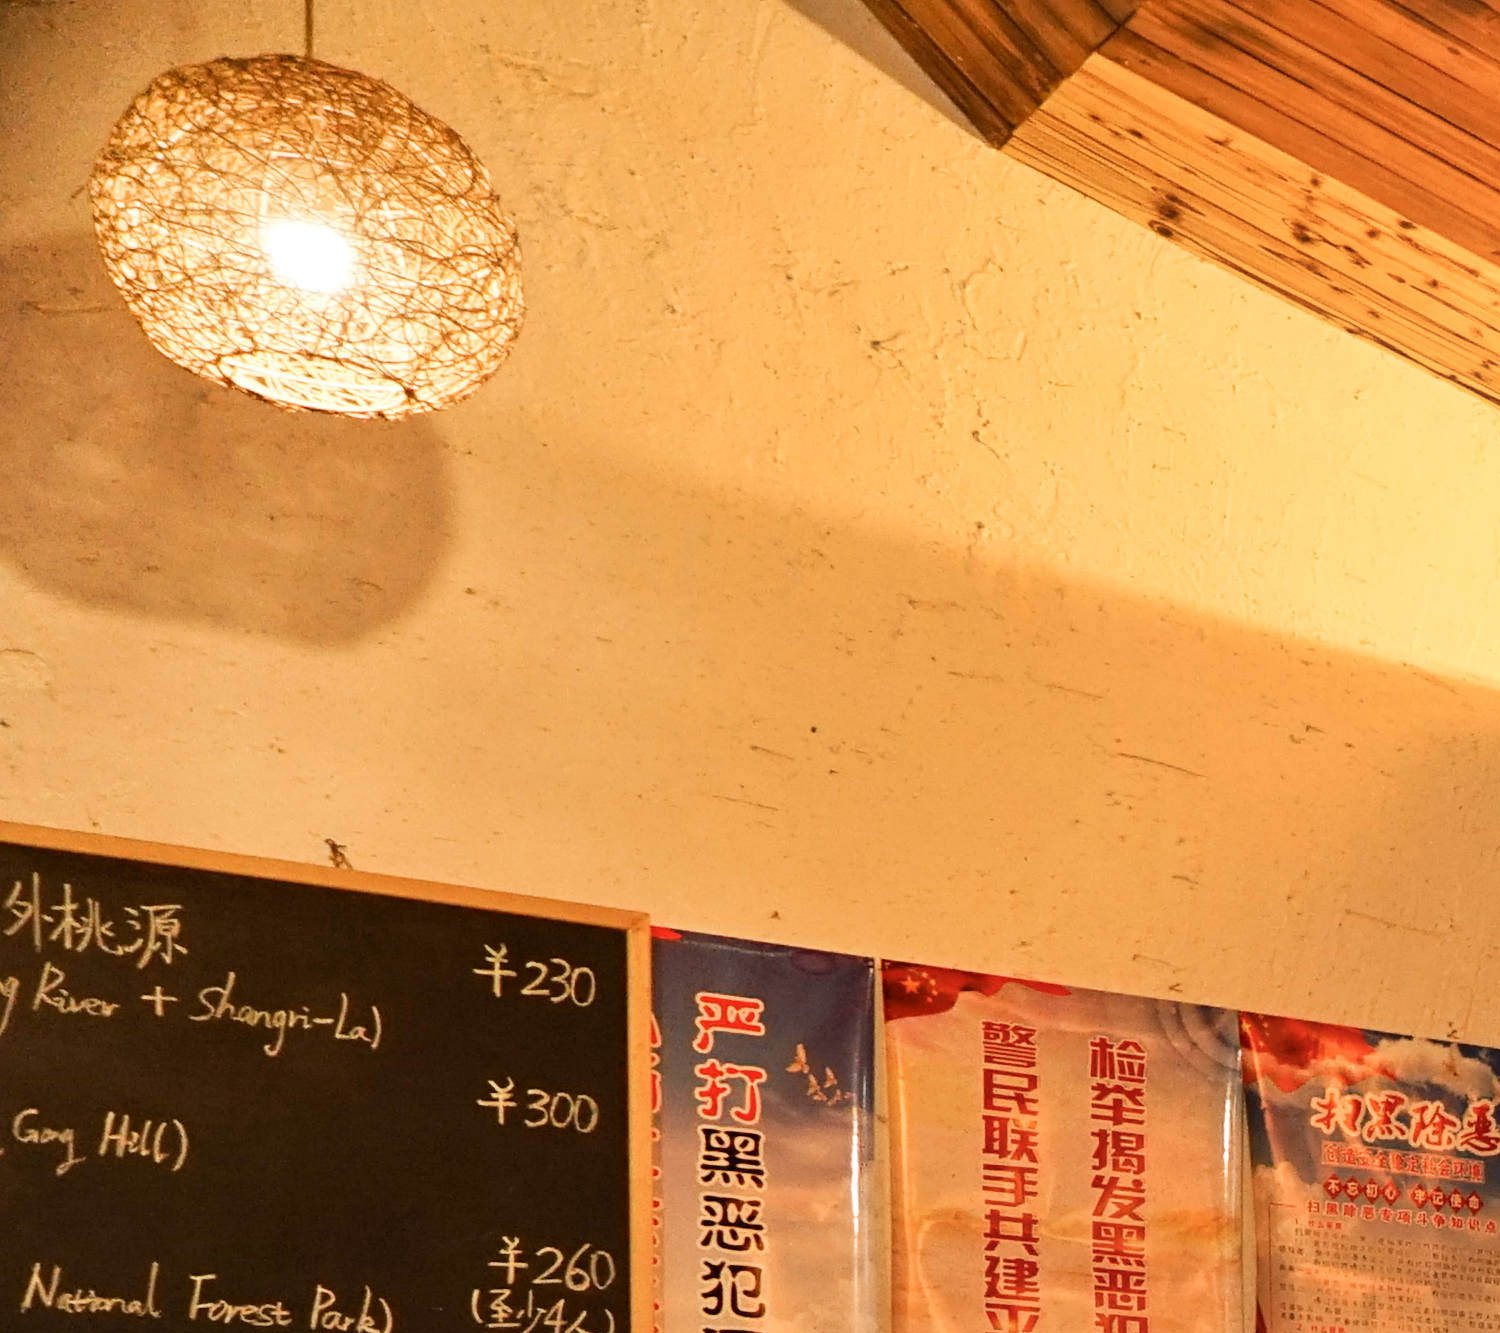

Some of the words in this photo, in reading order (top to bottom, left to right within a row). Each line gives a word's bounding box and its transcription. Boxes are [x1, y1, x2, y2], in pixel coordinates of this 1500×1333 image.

[472, 943, 595, 1008] ¥230
[478, 1076, 598, 1134] ¥300
[21, 1261, 161, 1320] National
[187, 1274, 292, 1326] Forest
[489, 1235, 616, 1292] ¥260
